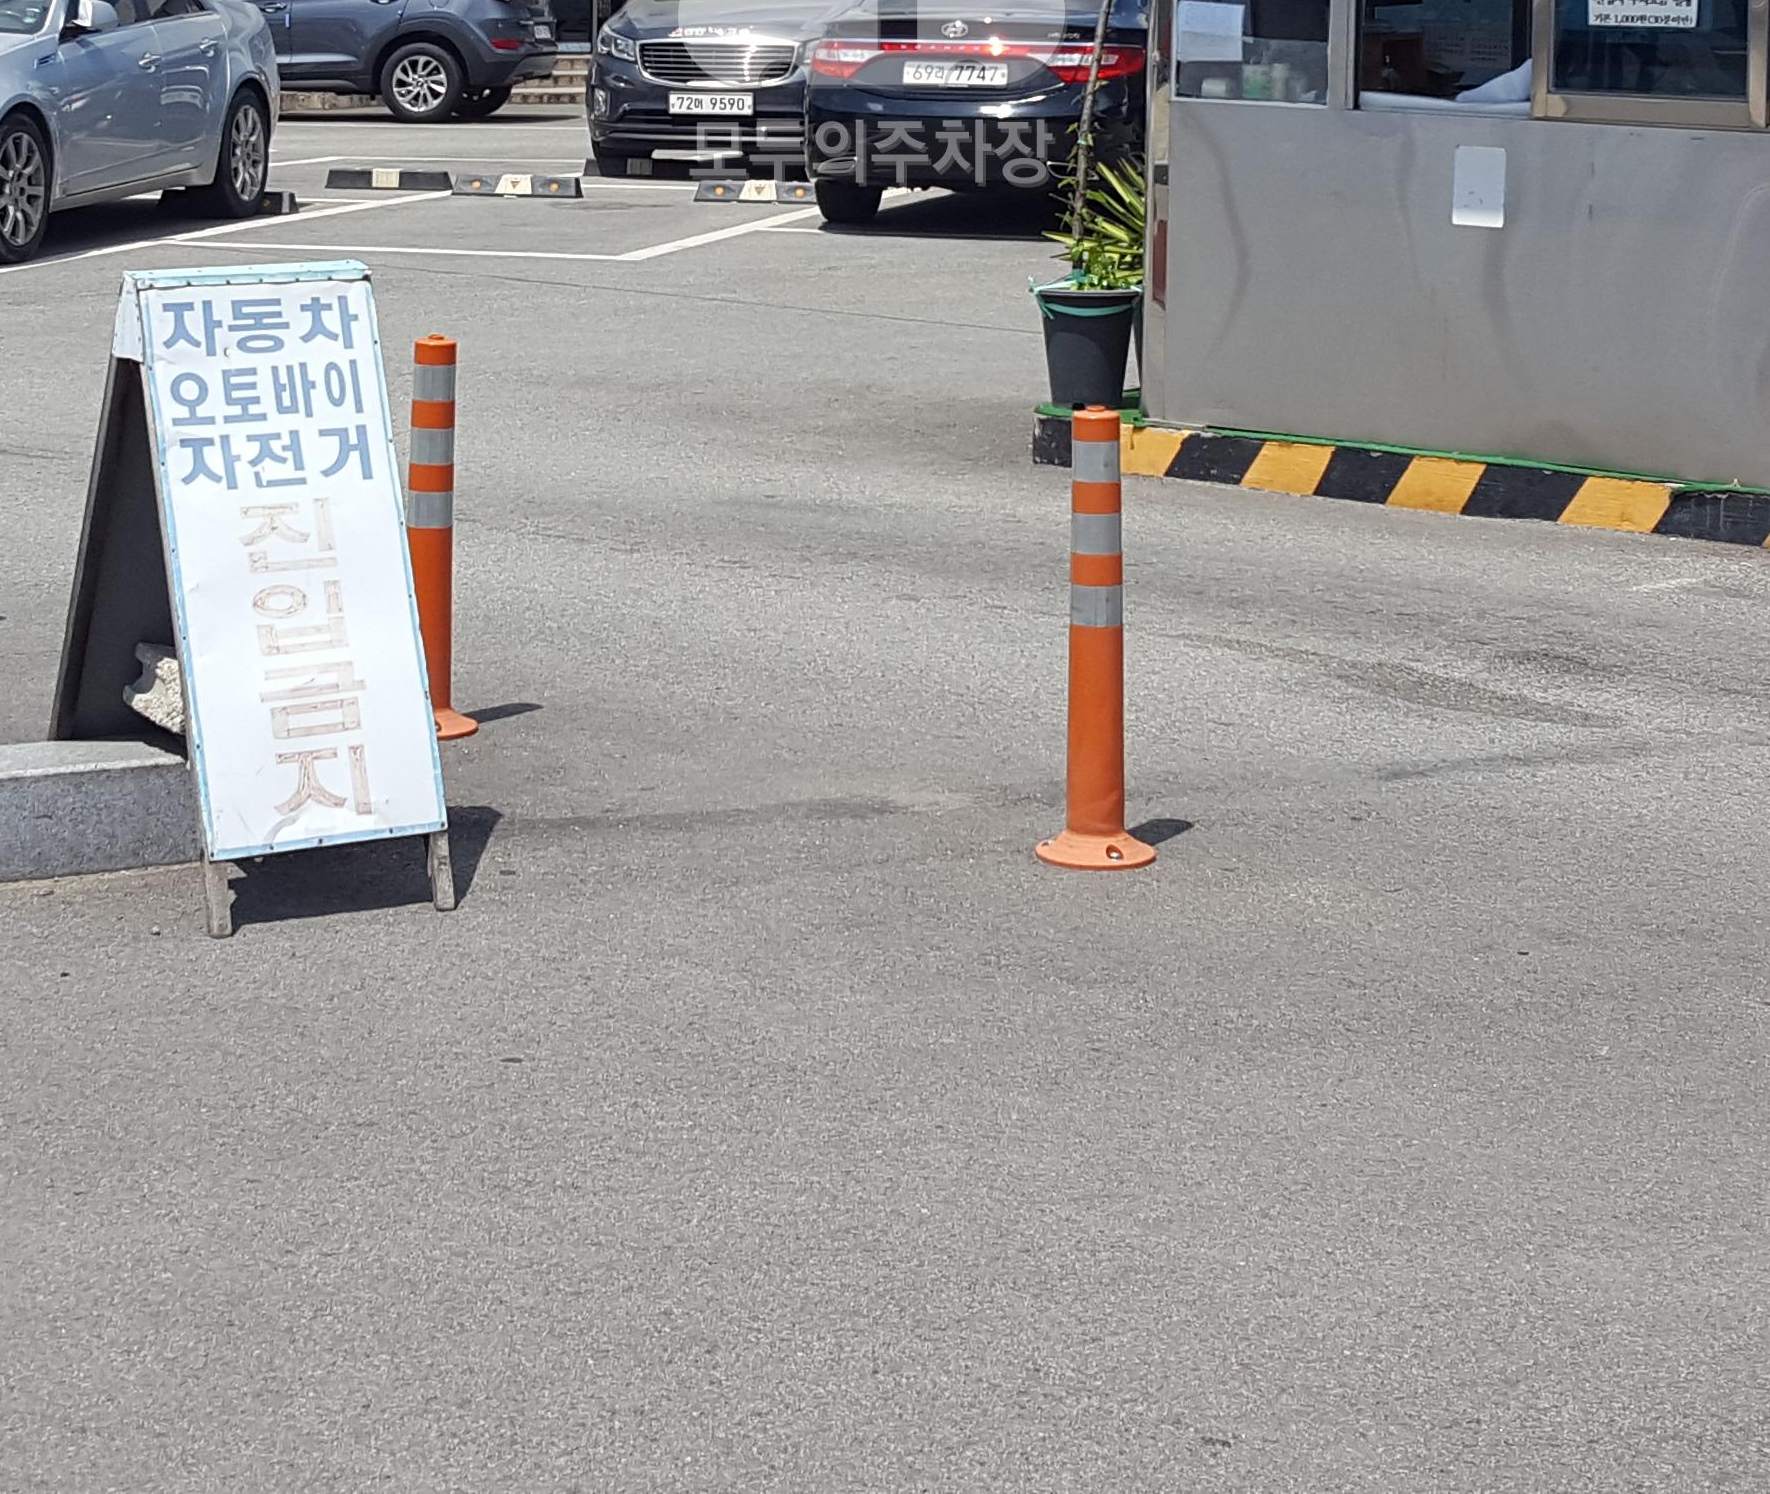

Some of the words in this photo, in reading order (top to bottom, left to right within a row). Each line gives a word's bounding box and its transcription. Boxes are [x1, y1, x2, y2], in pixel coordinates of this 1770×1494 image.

[709, 97, 745, 112] 9590
[912, 64, 945, 81] 69라
[955, 65, 999, 81] 7747
[161, 294, 360, 358] 자동차
[169, 357, 365, 426] 오토바이
[178, 424, 376, 490] 자전거
[238, 496, 376, 817] 진입금지
